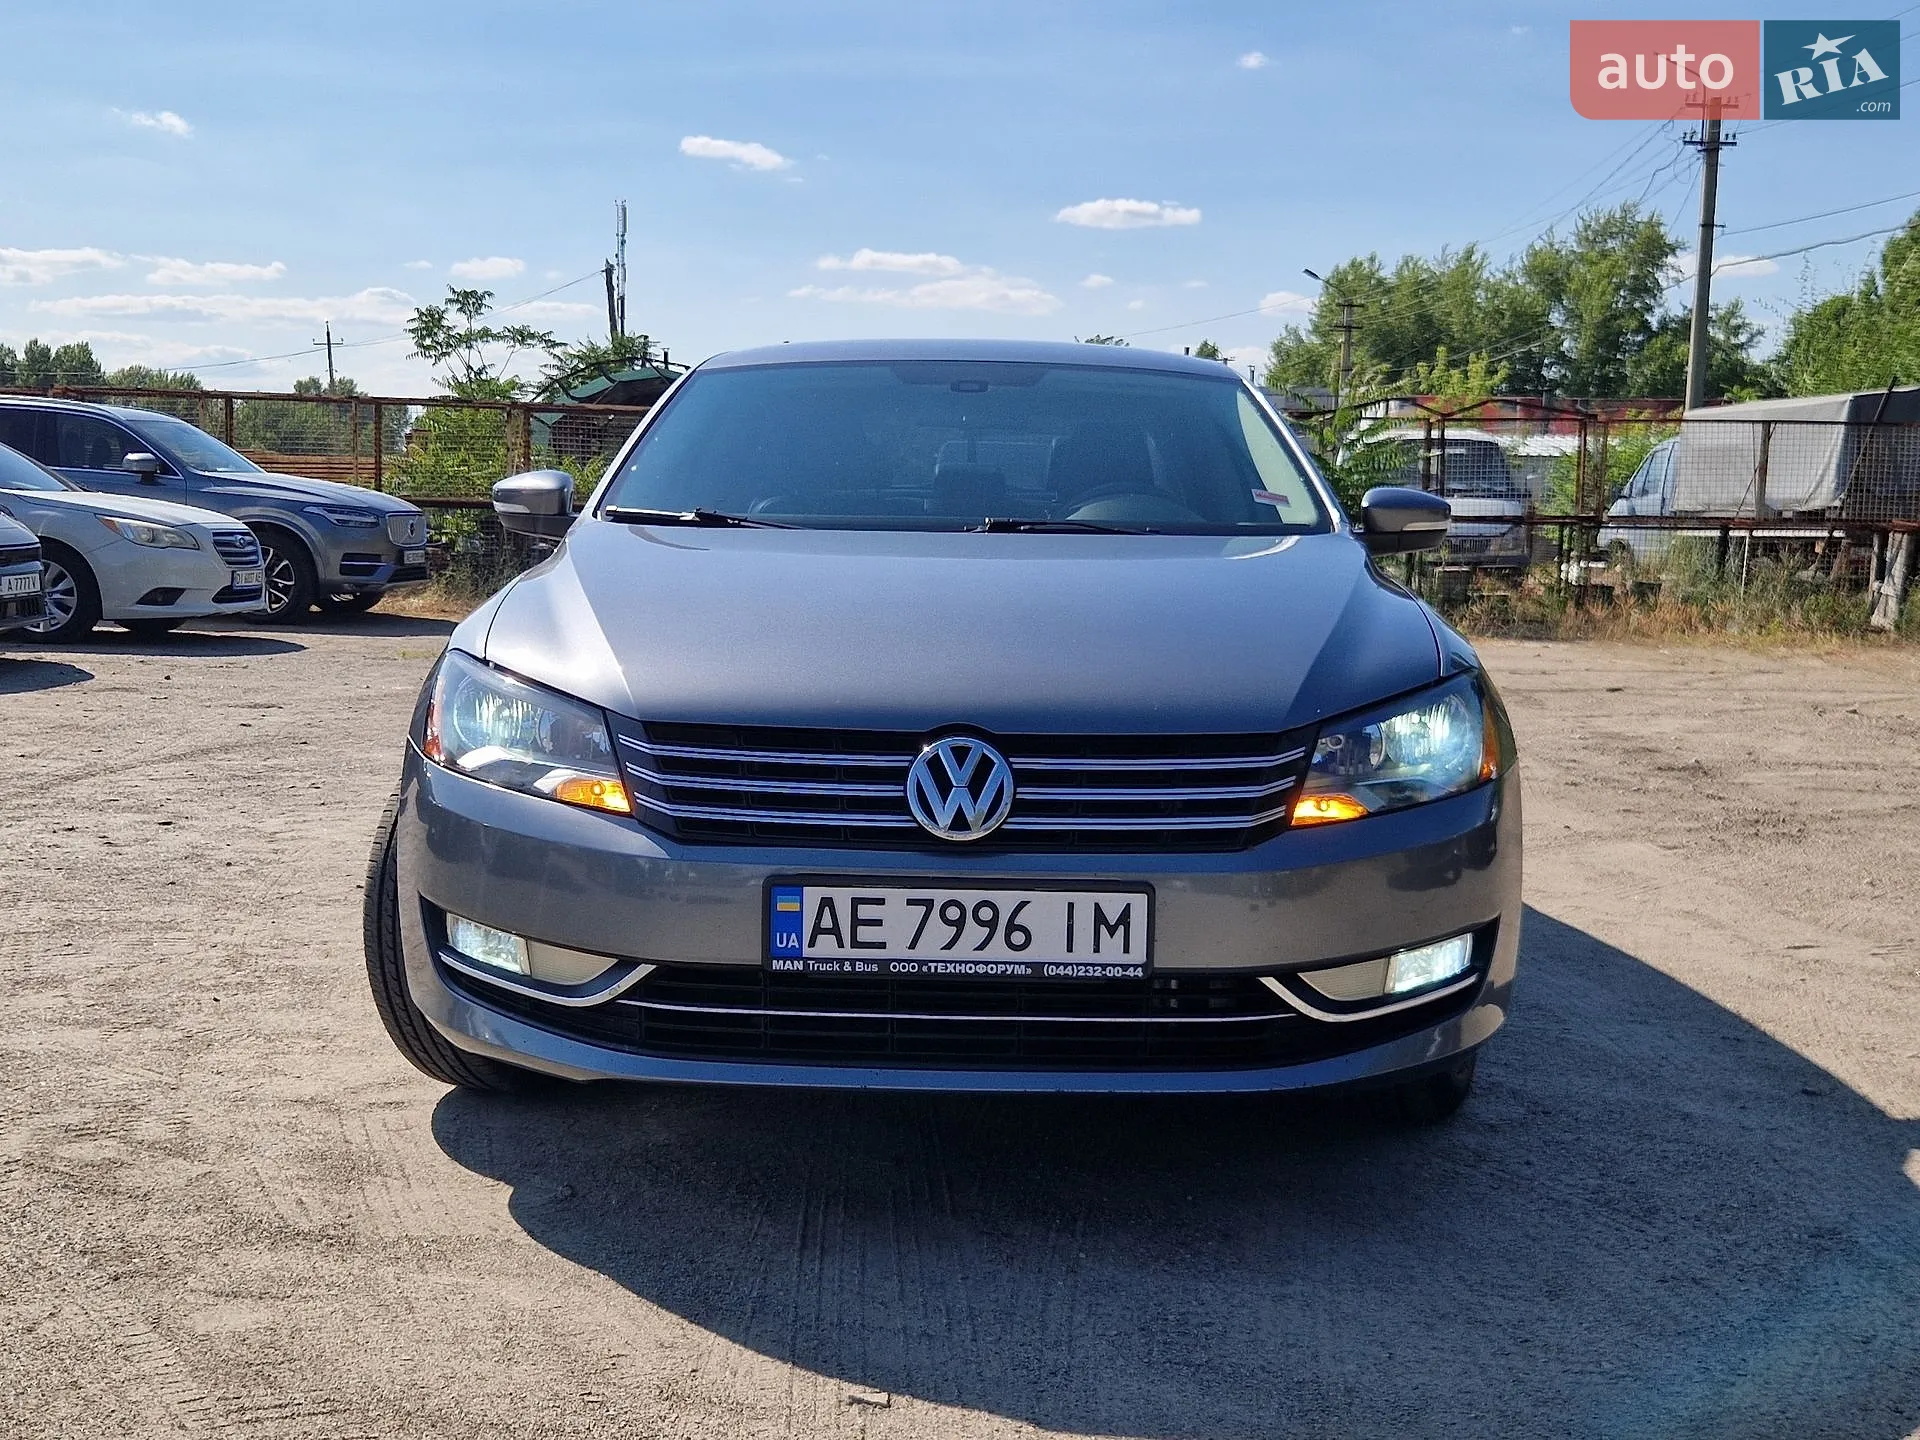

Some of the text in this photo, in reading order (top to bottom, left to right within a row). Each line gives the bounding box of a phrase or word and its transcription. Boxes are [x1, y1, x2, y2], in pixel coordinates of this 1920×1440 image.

[808, 896, 1132, 954] AE 7996 IM
[776, 932, 800, 948] UA
[772, 959, 879, 972] MAN Truck & Bus
[889, 962, 1144, 977] ООО «ТЕХНОФОРУМ» (044)232-00-44
